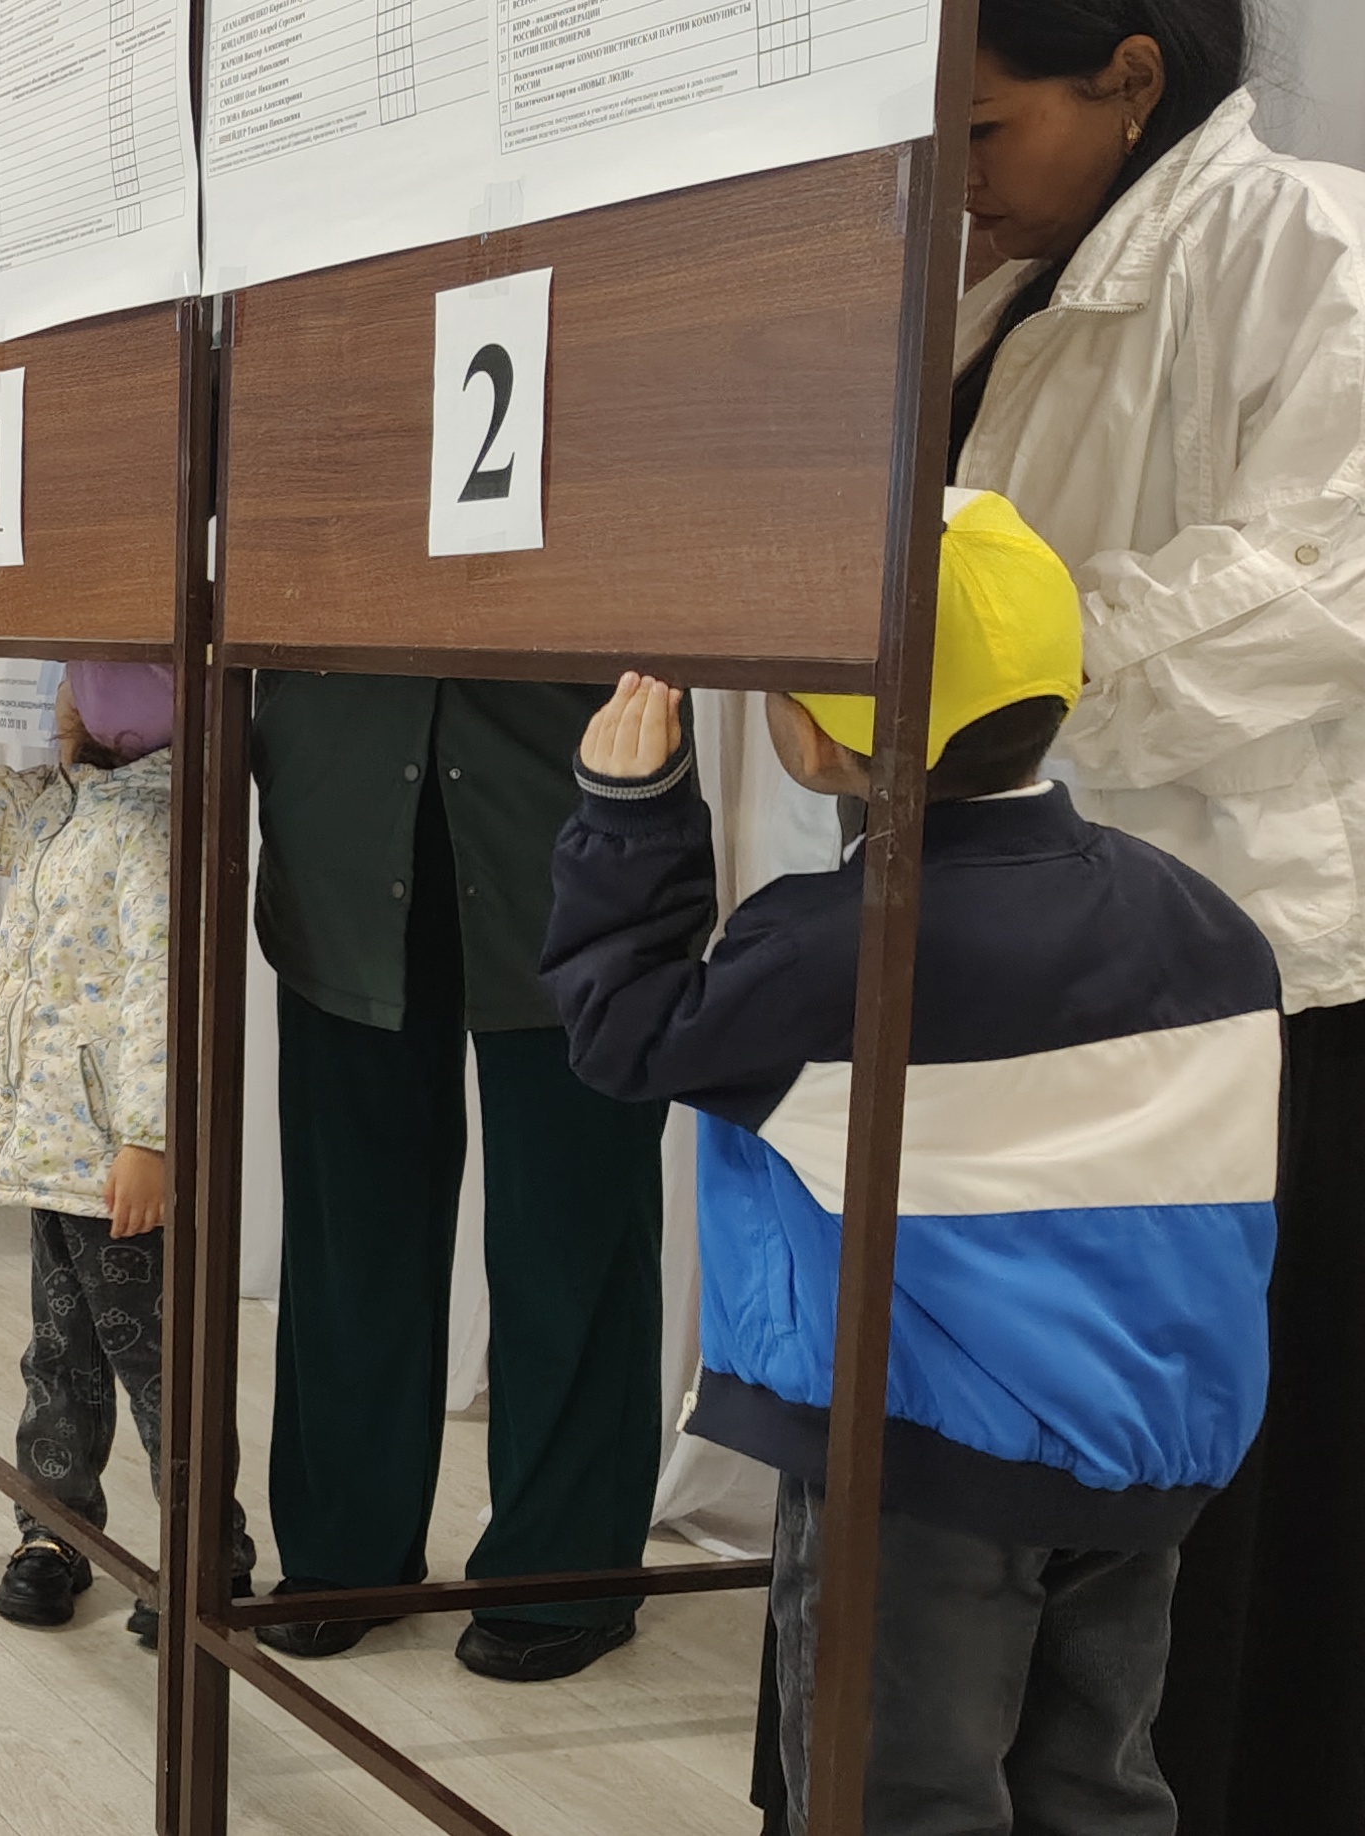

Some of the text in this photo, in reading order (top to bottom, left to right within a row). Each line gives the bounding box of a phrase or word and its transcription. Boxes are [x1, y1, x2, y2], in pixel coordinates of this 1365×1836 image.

[512, 7, 601, 44] РОССИЙСКОЙ ФЕДЕРАЦИИ
[576, 31, 658, 63] КОММУНИСТИЧЕСКАЯ
[658, 20, 690, 40] ПАРТИЯ
[691, 2, 752, 29] КОММУНИСТЫ
[512, 43, 539, 60] ПАРТИЯ
[513, 78, 542, 95] РОССИИ
[457, 343, 515, 503] 2
